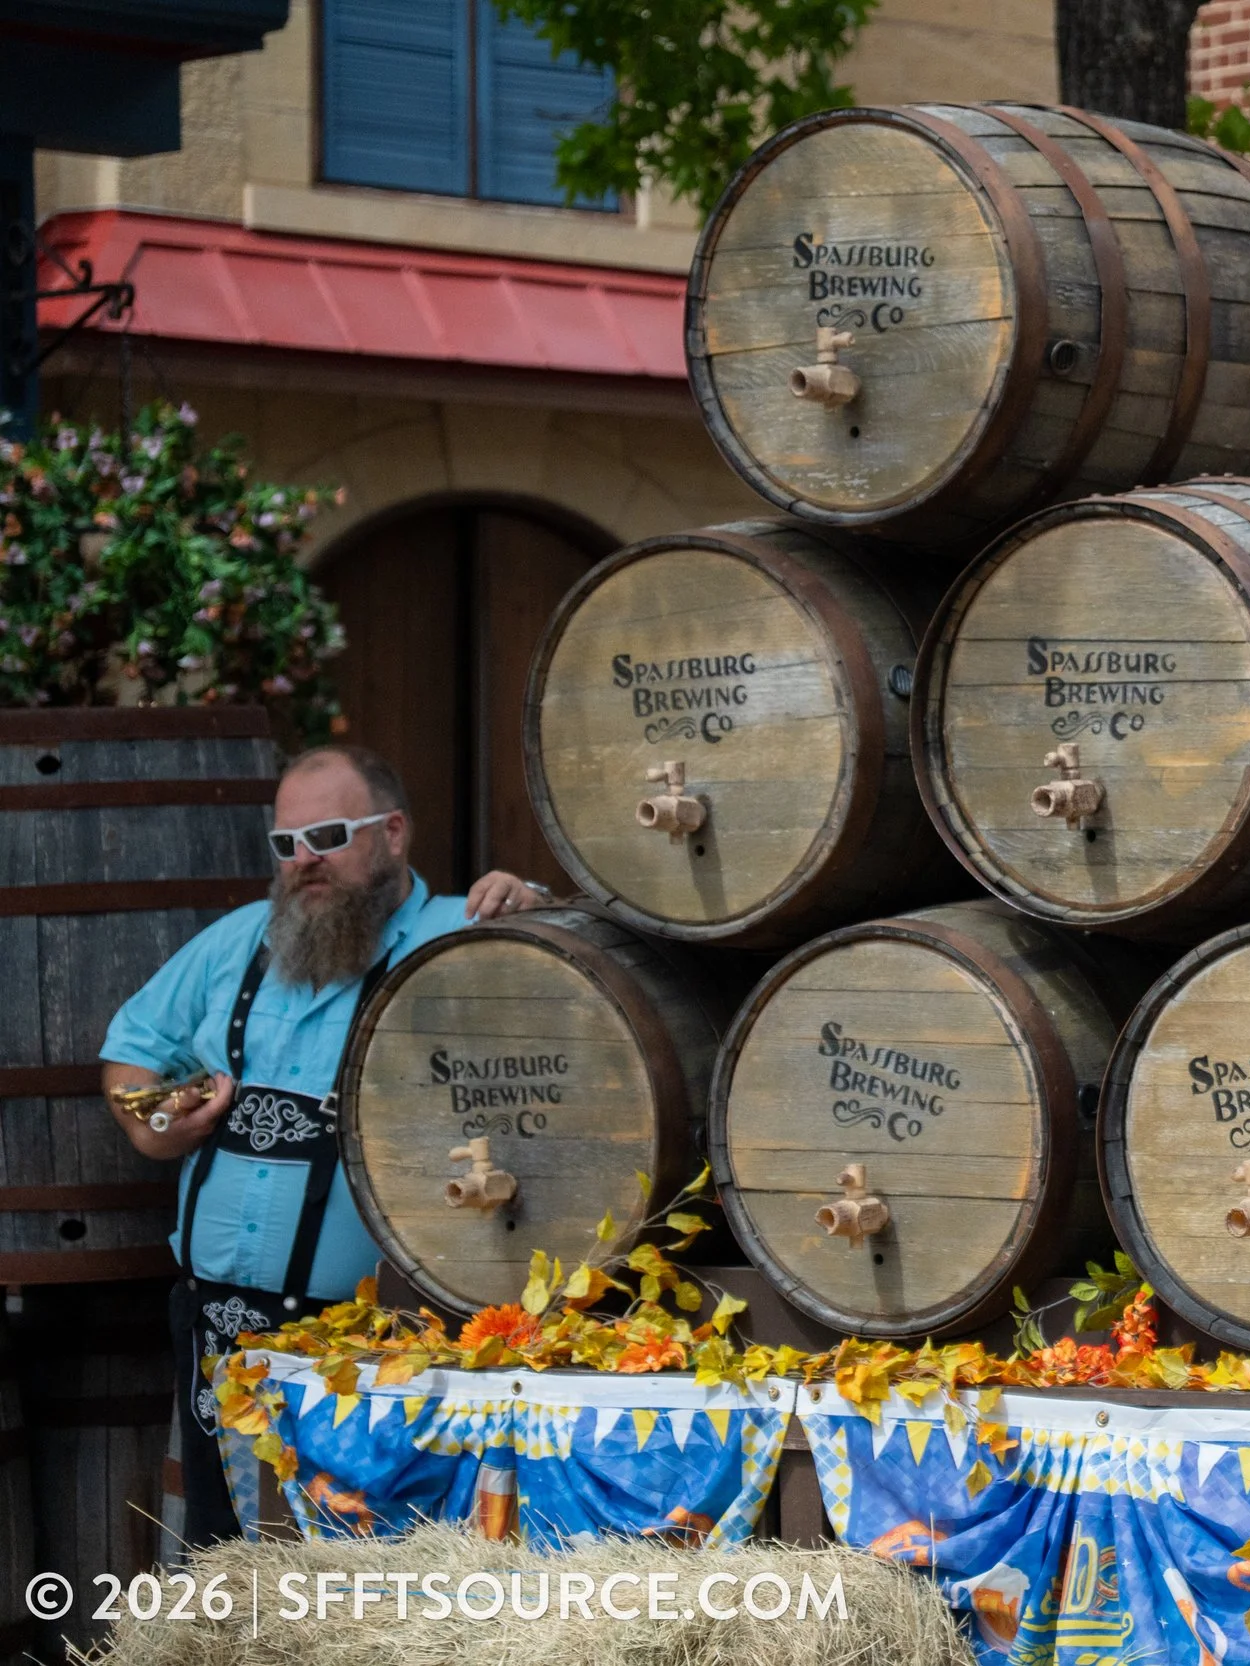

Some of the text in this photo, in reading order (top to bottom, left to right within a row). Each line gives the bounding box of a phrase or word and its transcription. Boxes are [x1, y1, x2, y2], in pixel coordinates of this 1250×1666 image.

[793, 232, 935, 268] SPASSBURG
[809, 270, 922, 301] BREWING
[612, 653, 756, 689] SPASSBURG
[1027, 636, 1177, 676] SPASSBURG
[633, 684, 748, 718] BREWING
[1044, 676, 1165, 708] BREWING
[429, 1050, 569, 1085] SPASSBURG
[818, 1021, 961, 1090] SPASSBURG
[451, 1083, 563, 1113] BREWING
[829, 1060, 944, 1117] BREWING
